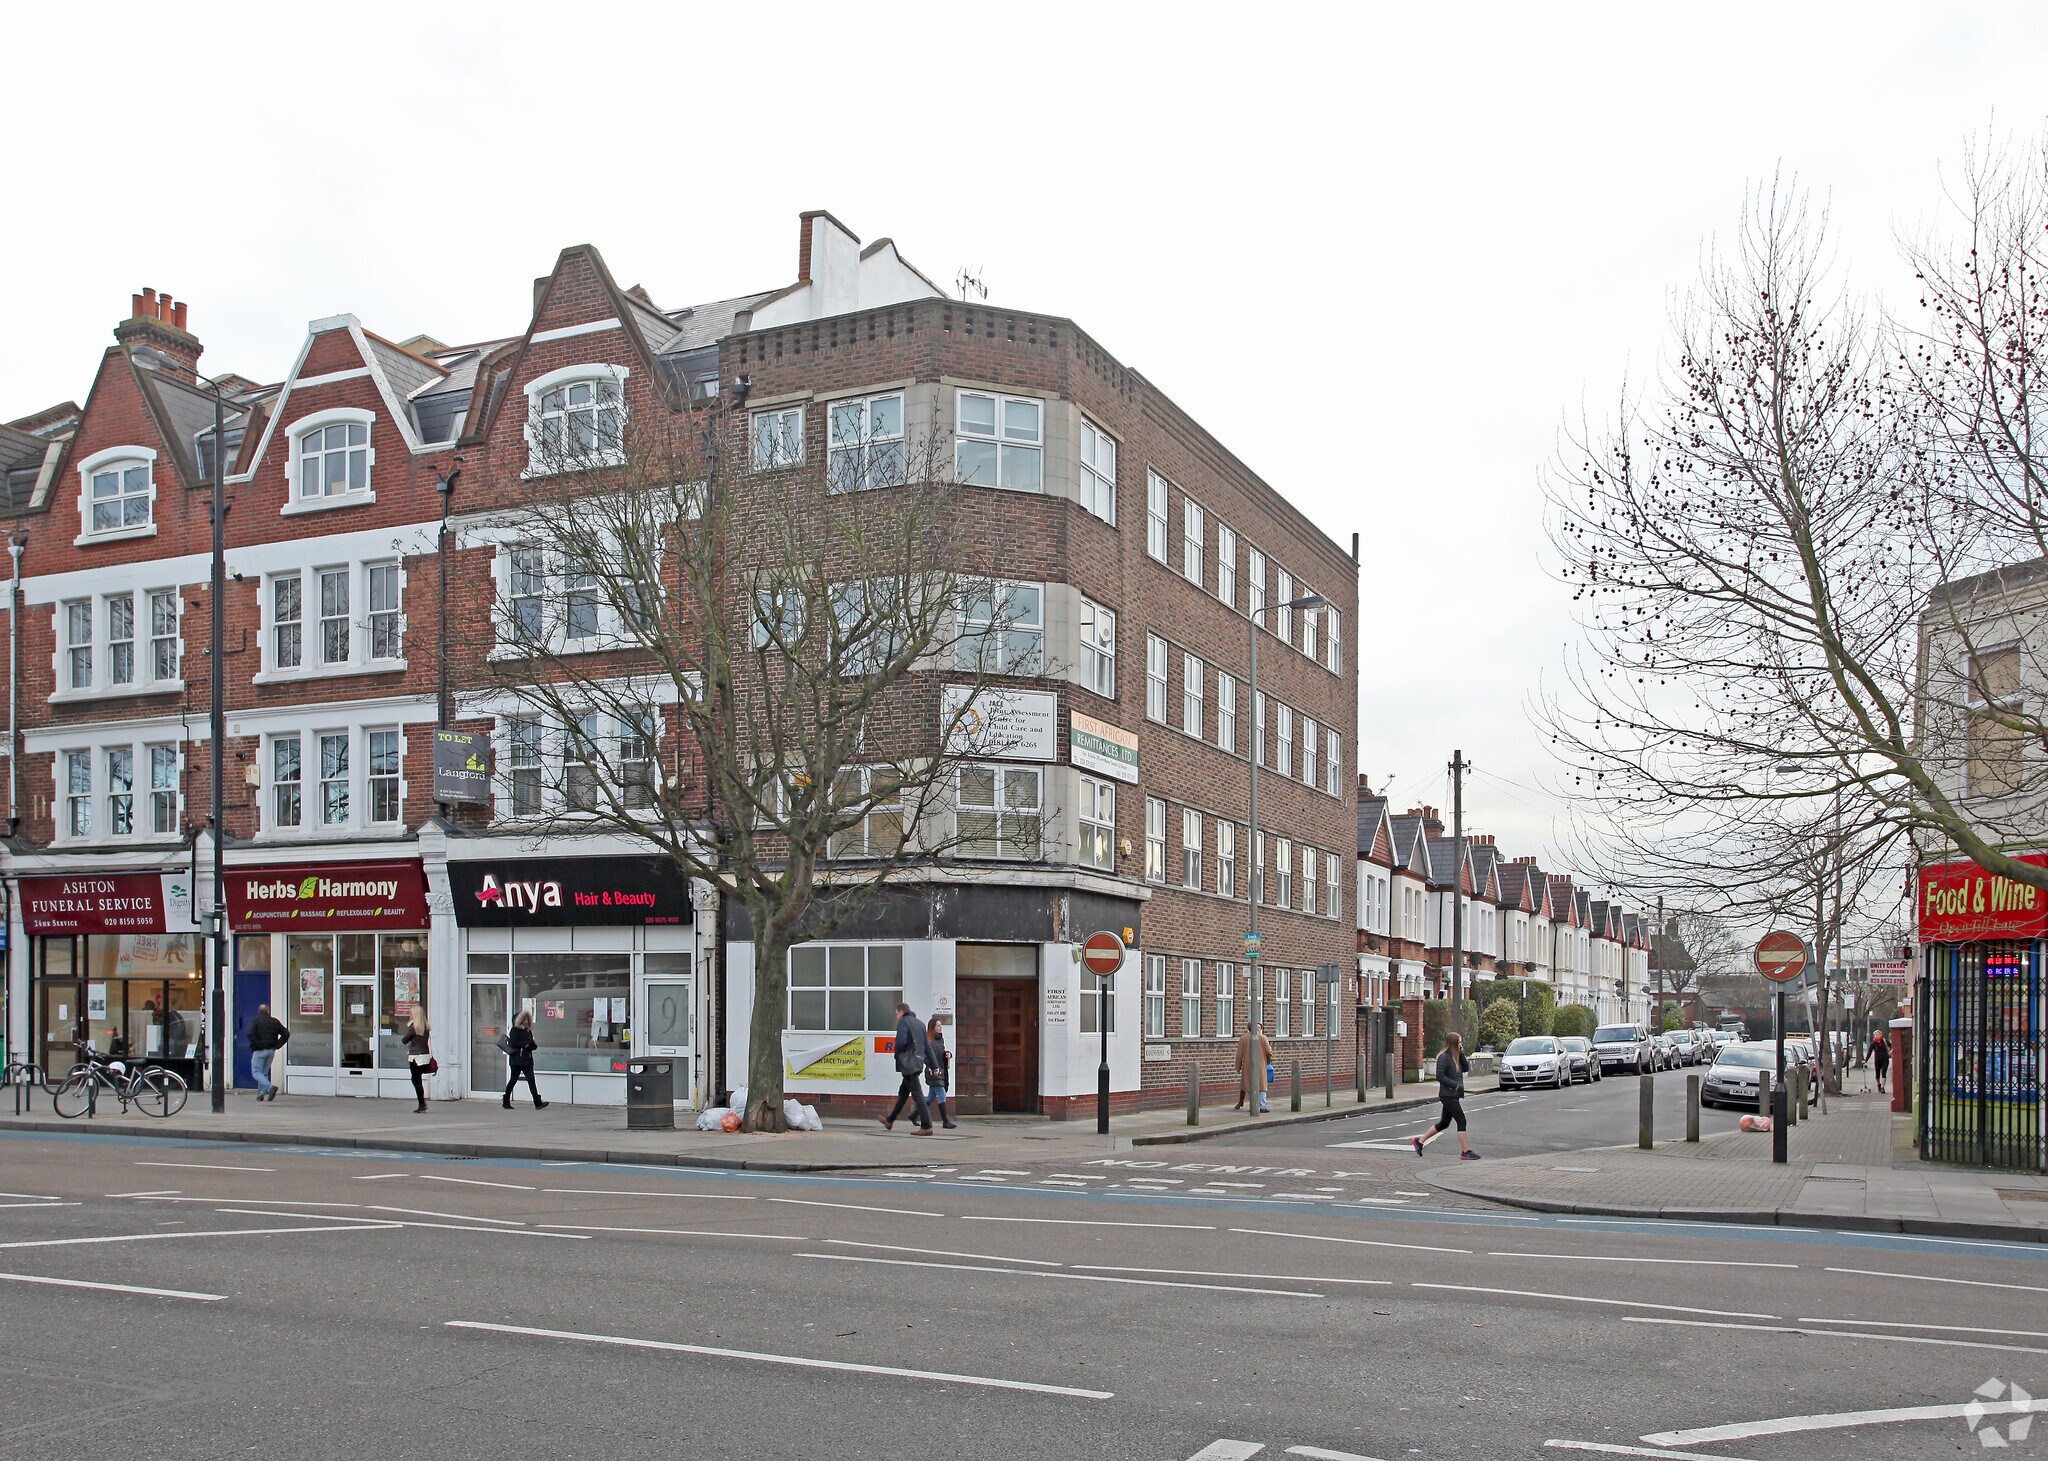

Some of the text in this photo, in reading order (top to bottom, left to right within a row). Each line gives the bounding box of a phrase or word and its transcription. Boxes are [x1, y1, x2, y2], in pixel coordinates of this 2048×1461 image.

[437, 733, 473, 744] TO LET
[1078, 716, 1132, 746] FIRST AFRICAN
[1076, 733, 1119, 758] REMITTANCES
[1121, 749, 1132, 762] LTD
[62, 880, 116, 894] ASHTON
[246, 877, 399, 900] Herbs Harmony
[480, 873, 564, 914] Anya
[31, 897, 152, 913] FUNERAL SERVICE
[169, 898, 191, 909] Dignity
[574, 890, 656, 908] Hair & Beauty
[1925, 876, 2036, 917] Food & Wine
[104, 917, 154, 926] 020 8150 5050
[252, 908, 406, 919] ACUPUNCTURE MASSAGE REFLEXOLOGY BEAUTY
[661, 996, 677, 1034] 9
[837, 1058, 859, 1066] Training
[1081, 1159, 1372, 1178] NO ENTRY
